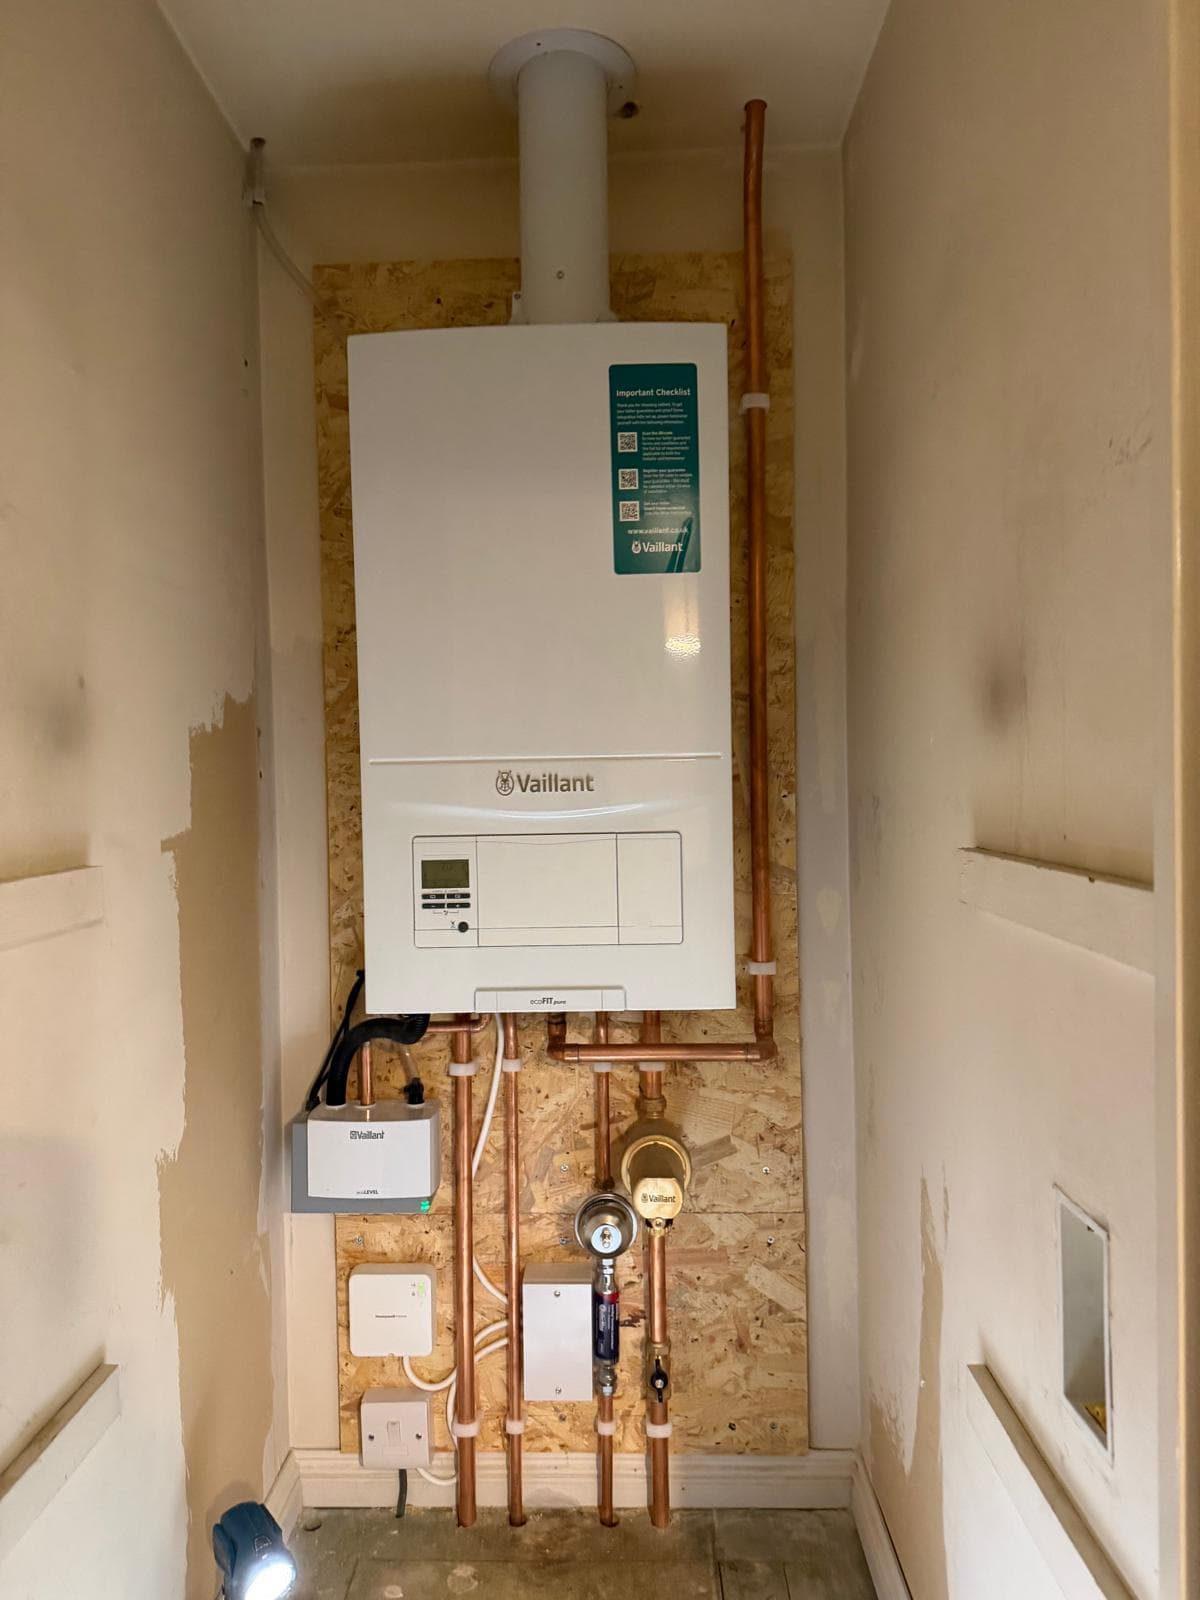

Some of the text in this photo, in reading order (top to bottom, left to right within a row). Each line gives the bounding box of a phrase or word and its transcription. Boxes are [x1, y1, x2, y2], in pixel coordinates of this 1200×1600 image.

[616, 388, 691, 398] Important Checklist
[642, 541, 683, 553] Vaillant
[517, 773, 595, 793] Vaillant
[530, 997, 553, 1005] ecoFIT
[357, 1130, 385, 1140] Vaillant
[649, 1194, 676, 1203] Vaillant
